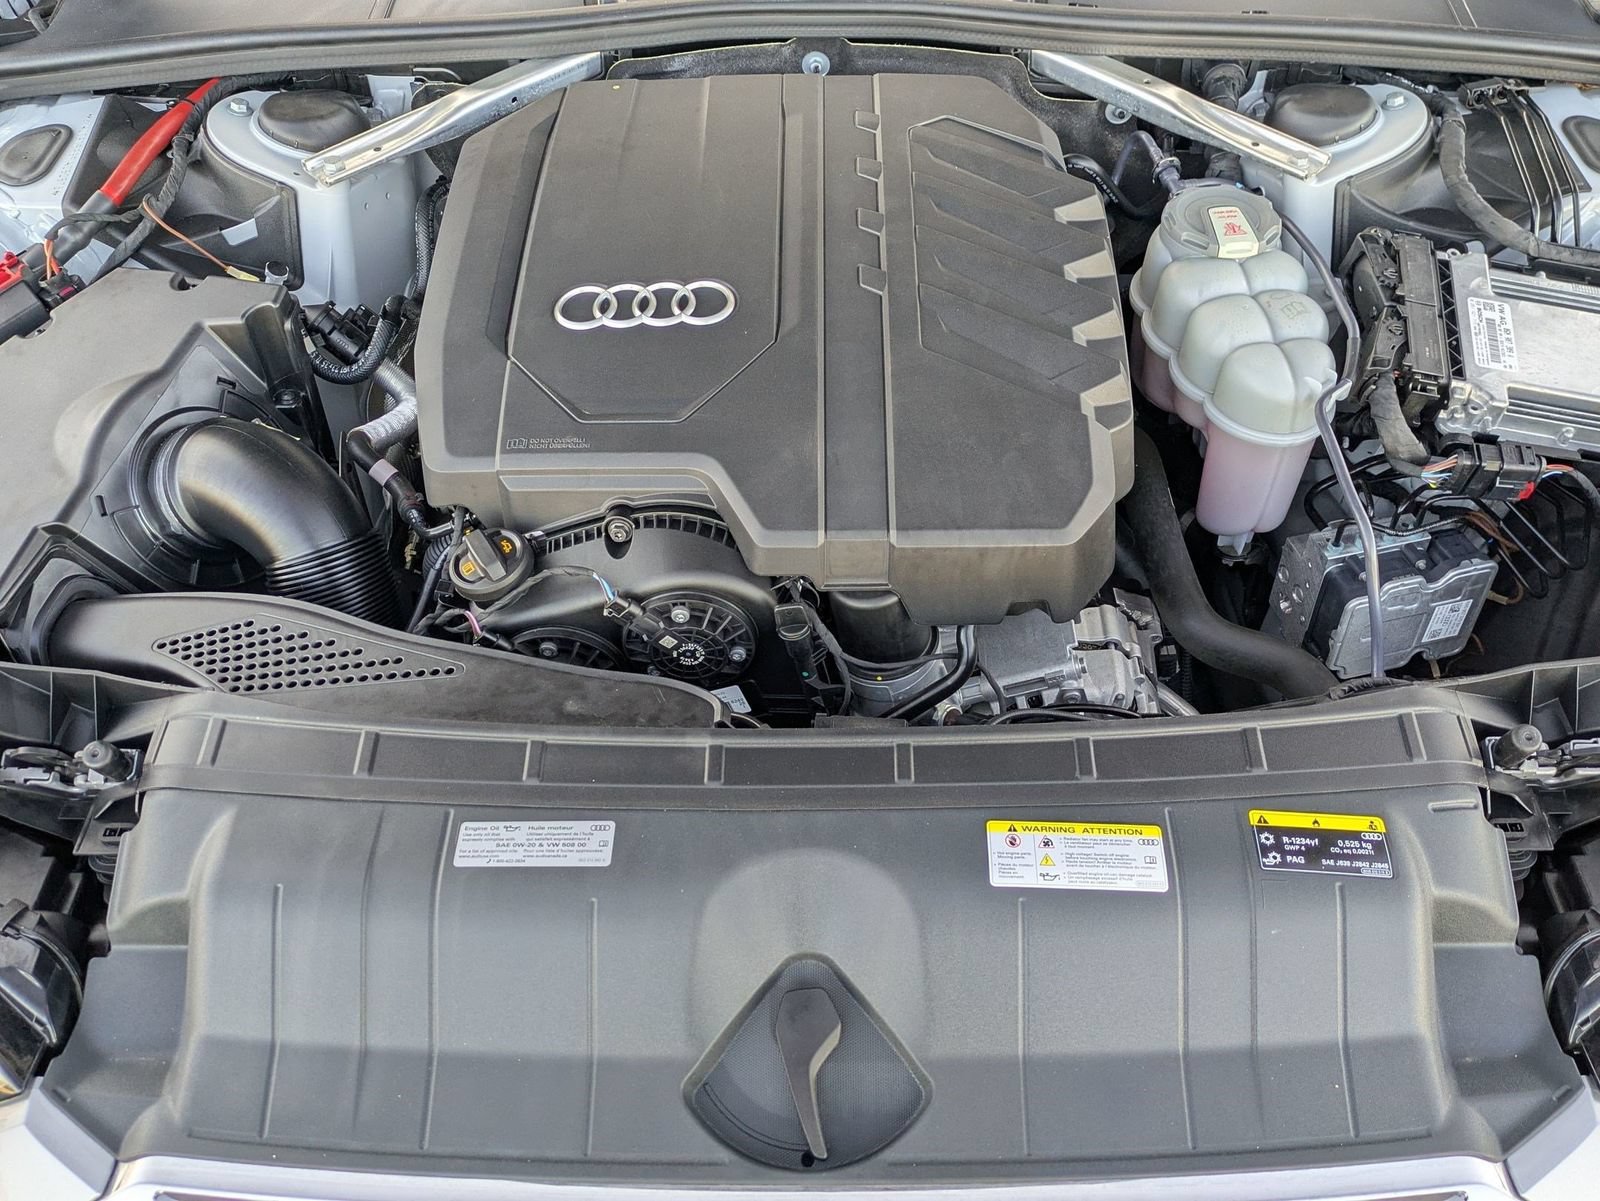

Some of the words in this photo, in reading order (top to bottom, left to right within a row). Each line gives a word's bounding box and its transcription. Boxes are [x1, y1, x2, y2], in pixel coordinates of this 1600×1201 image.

[1497, 304, 1505, 314] VW
[1499, 315, 1507, 325] AG
[1021, 825, 1075, 833] WARNING
[1282, 836, 1319, 846] R-1234yf
[1337, 840, 1360, 848] 0,525
[1361, 841, 1372, 849] kg
[1286, 856, 1305, 864] PAG
